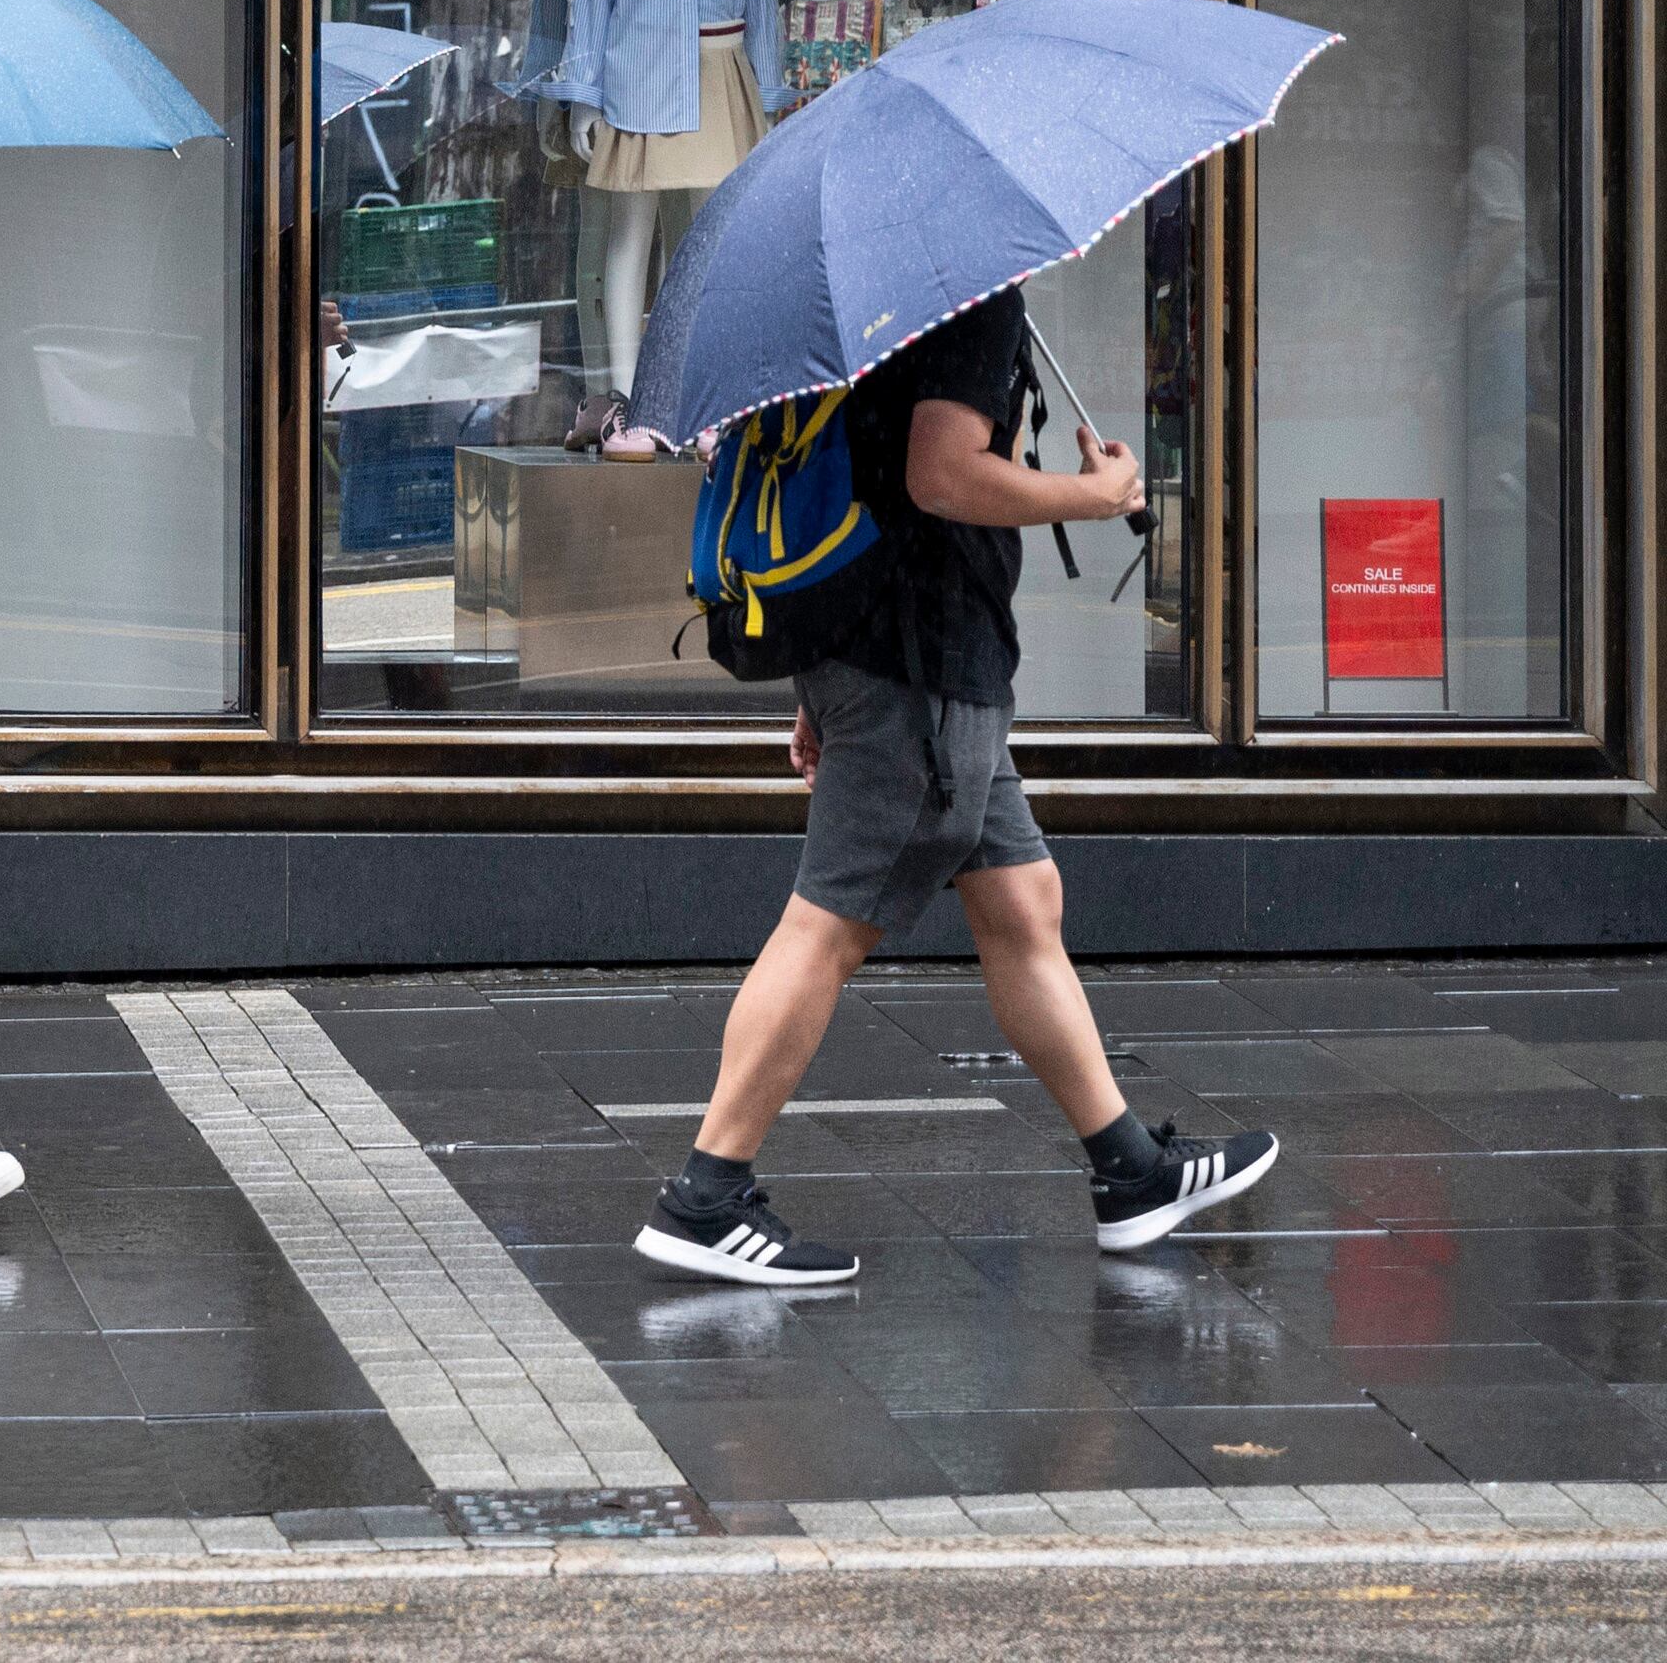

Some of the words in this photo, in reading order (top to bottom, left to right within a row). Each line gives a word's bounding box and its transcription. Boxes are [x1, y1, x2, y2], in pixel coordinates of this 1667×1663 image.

[1364, 568, 1403, 581] SALE
[1331, 583, 1397, 594] CONTINUES
[1399, 583, 1436, 594] INSIDE
